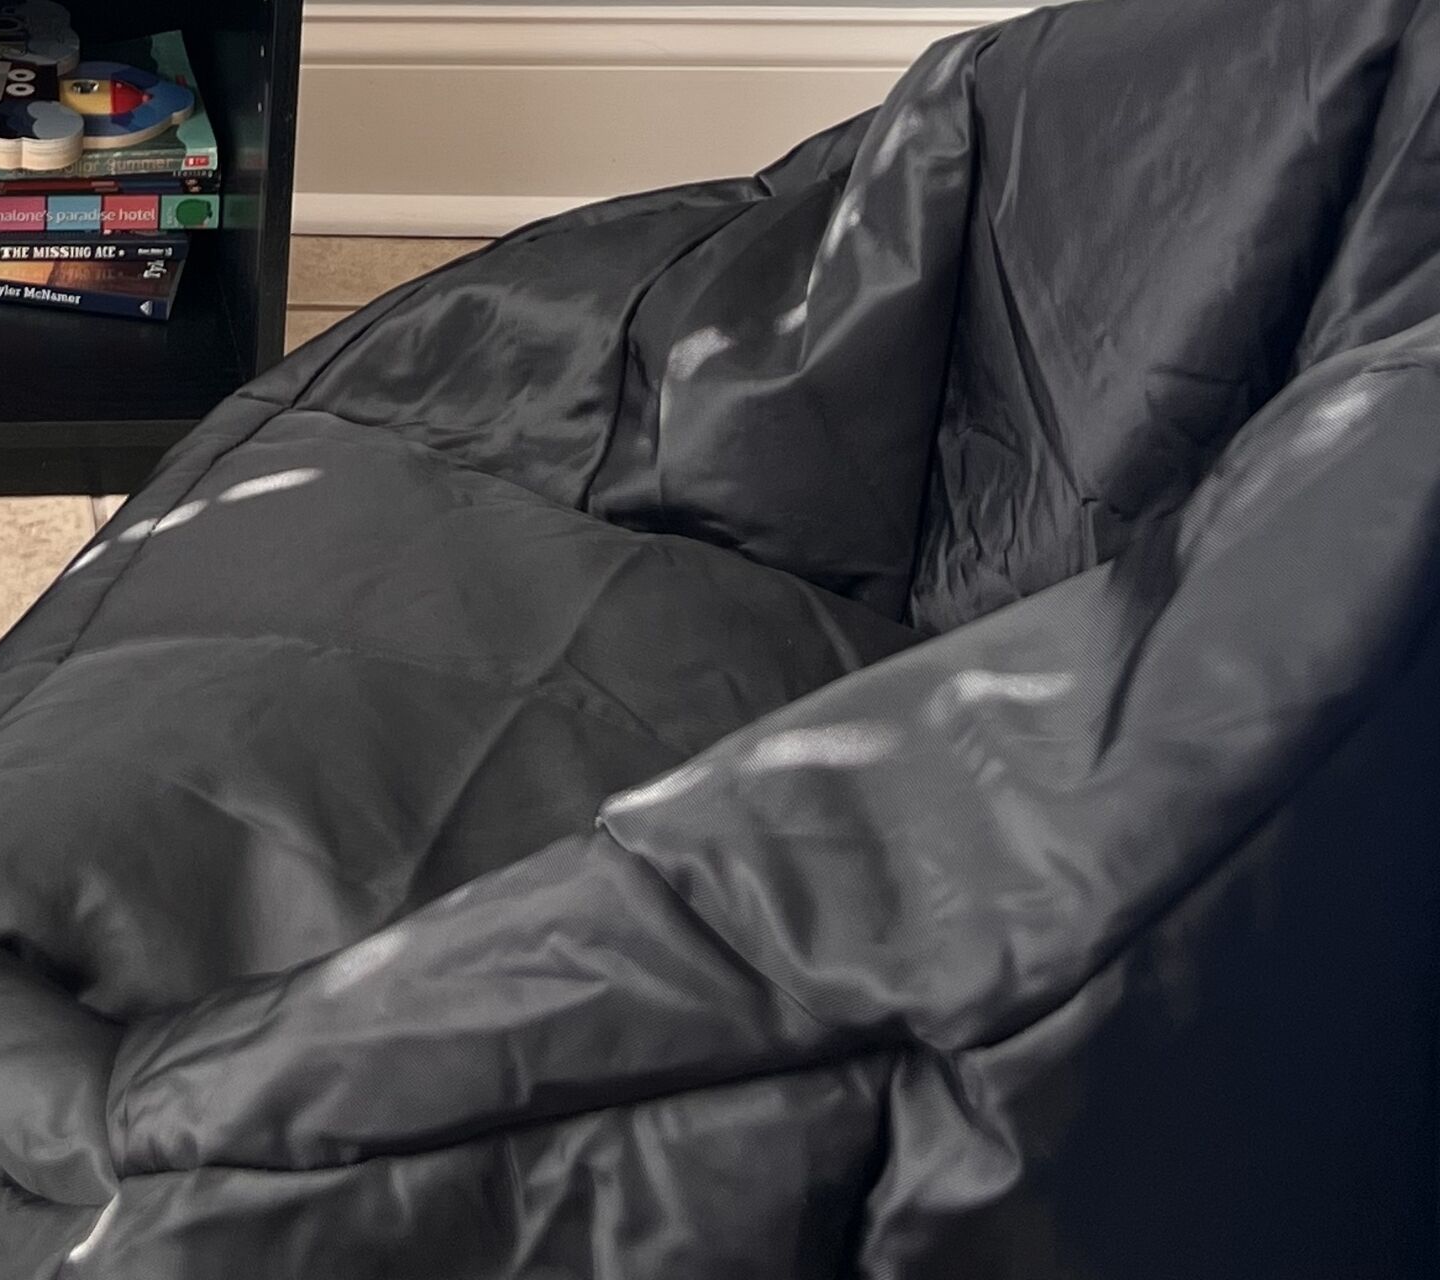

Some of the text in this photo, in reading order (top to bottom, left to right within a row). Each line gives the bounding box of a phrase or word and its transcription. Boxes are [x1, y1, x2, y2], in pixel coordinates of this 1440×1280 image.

[58, 208, 116, 224] paradise
[118, 207, 156, 221] hotel
[0, 246, 29, 259] THE
[33, 246, 91, 259] MISSING
[94, 246, 117, 258] ACE
[23, 286, 81, 306] McNamer
